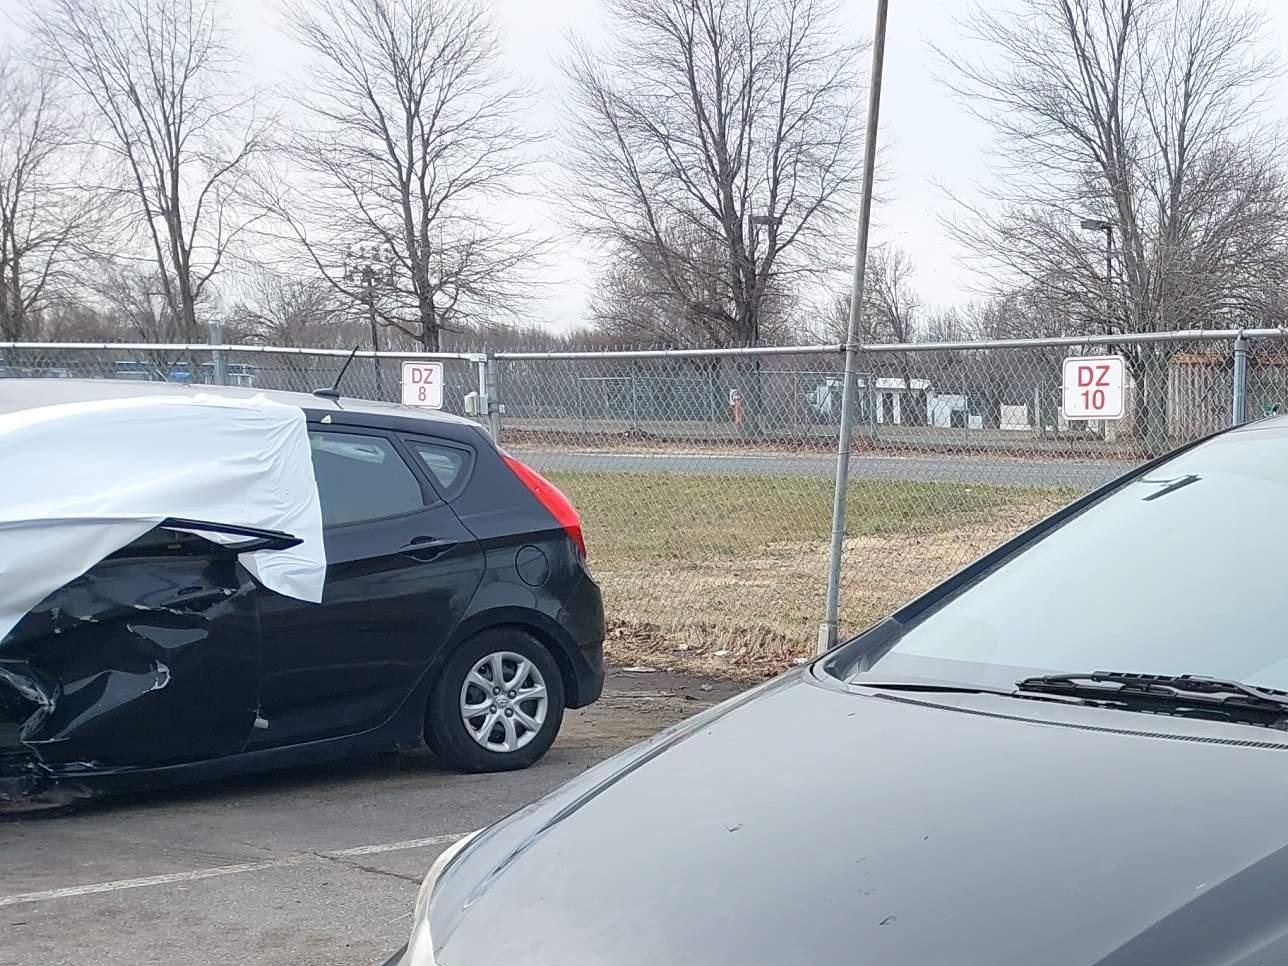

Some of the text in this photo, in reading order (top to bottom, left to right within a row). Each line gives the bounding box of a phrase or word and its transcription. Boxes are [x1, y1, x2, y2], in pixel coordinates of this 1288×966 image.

[412, 368, 433, 384] DZ
[1078, 365, 1110, 387] DZ
[418, 386, 426, 401] 8
[1081, 390, 1105, 410] 10
